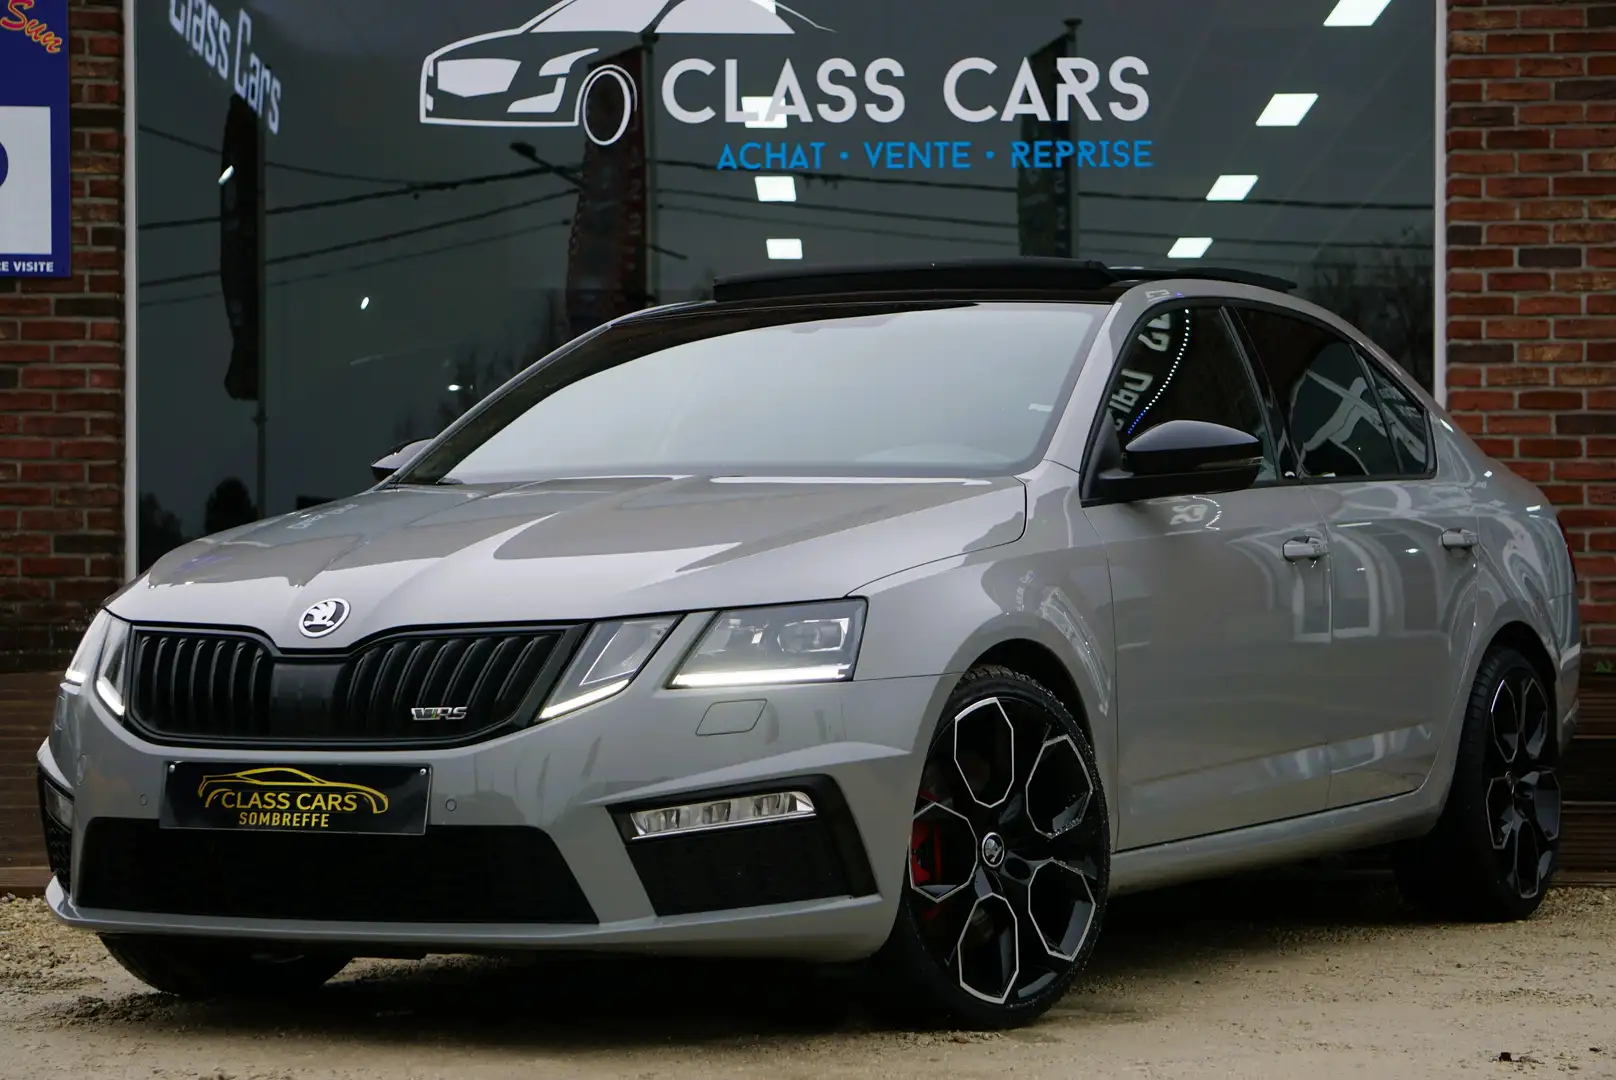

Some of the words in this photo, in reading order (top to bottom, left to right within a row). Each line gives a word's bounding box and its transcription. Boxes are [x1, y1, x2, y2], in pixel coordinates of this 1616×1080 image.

[0, 0, 62, 53] Sun
[234, 8, 281, 135] Cars
[662, 57, 905, 124] CLASS
[943, 56, 1150, 122] CARS
[716, 142, 826, 170] ACHAT
[862, 141, 971, 169] VENTE
[1010, 140, 1155, 168] REPRISE
[13, 261, 54, 273] VISITE
[221, 791, 290, 809] CLASS
[296, 793, 358, 811] CARS
[238, 811, 330, 828] SOMBREFFE
